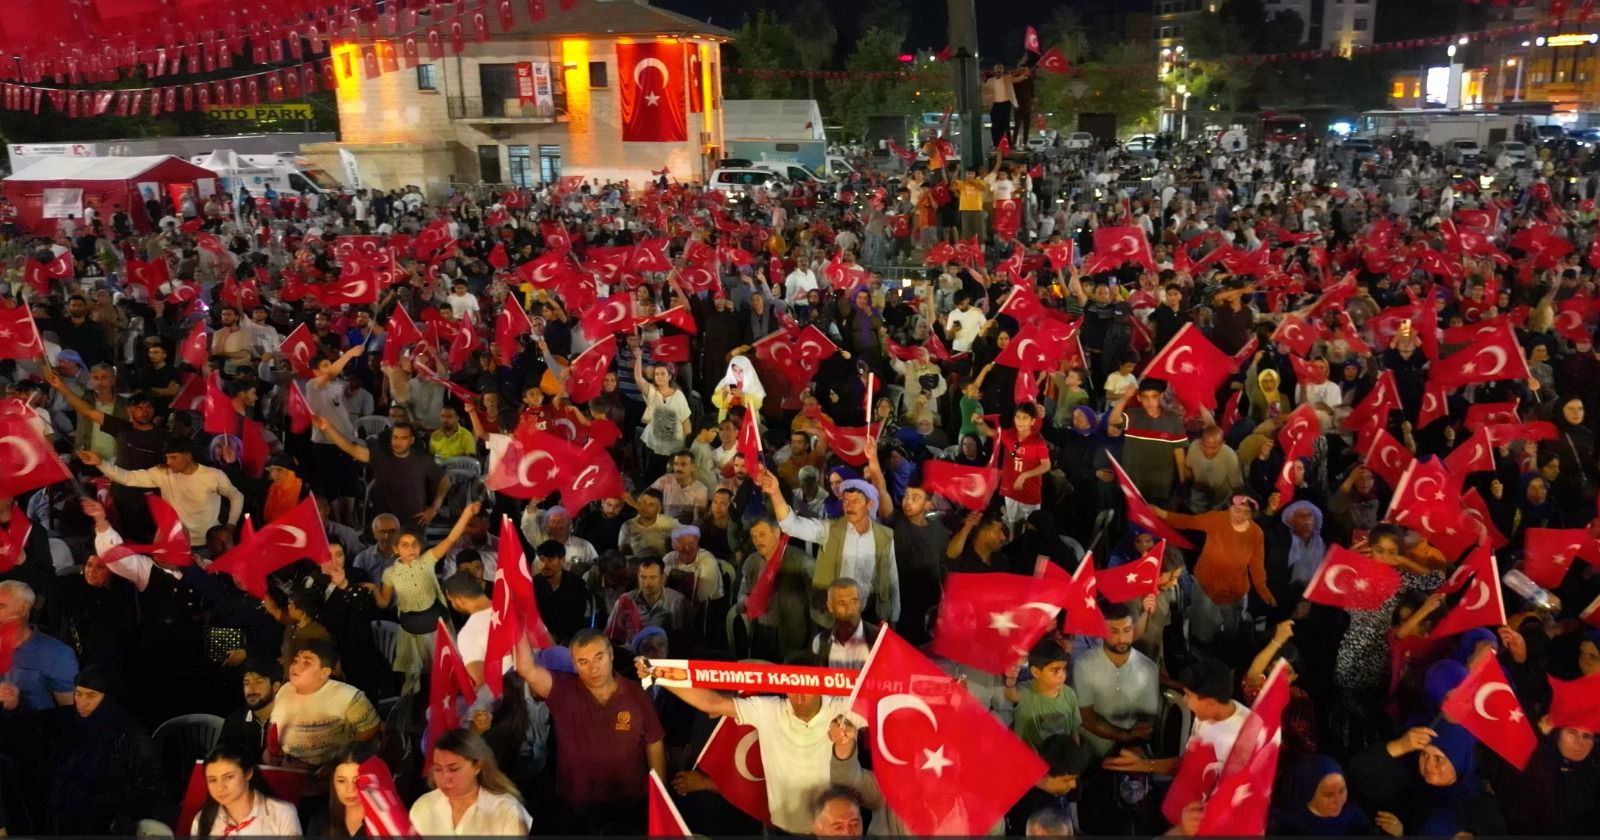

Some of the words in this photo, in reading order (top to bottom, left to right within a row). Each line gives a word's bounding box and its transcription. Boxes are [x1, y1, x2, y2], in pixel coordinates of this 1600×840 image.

[209, 109, 248, 120] OTO
[255, 109, 309, 120] PARK
[1014, 460, 1023, 472] 11
[695, 669, 764, 684] MEHMET
[767, 672, 820, 687] KASIM
